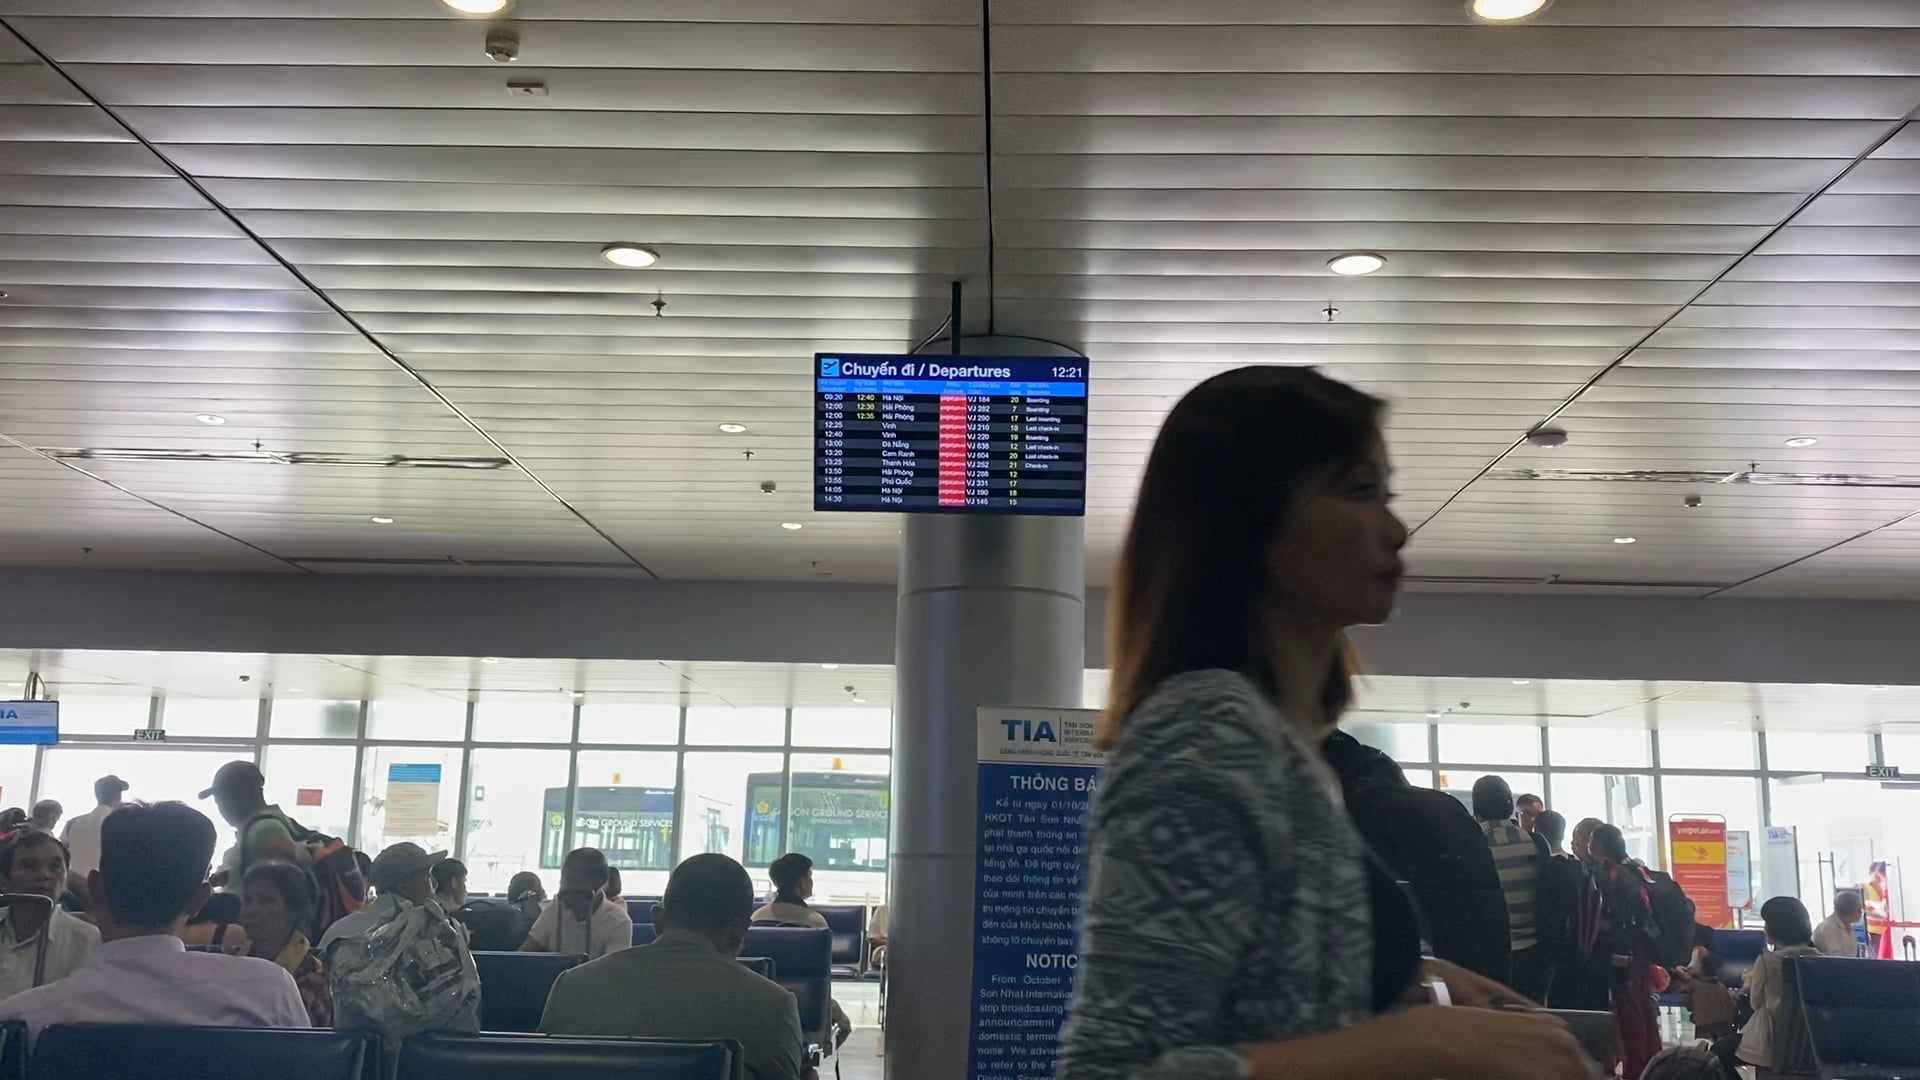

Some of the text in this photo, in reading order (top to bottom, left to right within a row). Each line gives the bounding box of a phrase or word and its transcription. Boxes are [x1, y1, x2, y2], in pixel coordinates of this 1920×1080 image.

[842, 362, 897, 378] Chuyến
[901, 364, 915, 376] đi
[929, 364, 1011, 380] Departures
[1052, 367, 1082, 378] 12:21
[0, 709, 18, 719] IA
[136, 730, 161, 740] EXIT
[1000, 719, 1057, 742] TIA
[1870, 767, 1896, 776] EXIT
[1010, 772, 1096, 792] THÔNG BÁ
[811, 808, 888, 818] GROUND SERVICE
[601, 819, 637, 827] GROUND
[984, 814, 1013, 823] HKQT
[1026, 954, 1078, 968] NOTIC
[992, 975, 1016, 983] From
[1024, 975, 1060, 985] October
[980, 989, 1072, 998] Son Nhat Internatio
[980, 1004, 1063, 1014] stop broadcasting
[979, 1019, 1054, 1027] announcement
[979, 1032, 1022, 1040] domestic
[1010, 1046, 1026, 1055] We
[1030, 1047, 1056, 1055] advis
[991, 1061, 1013, 1069] refer
[1031, 1061, 1046, 1069] the
